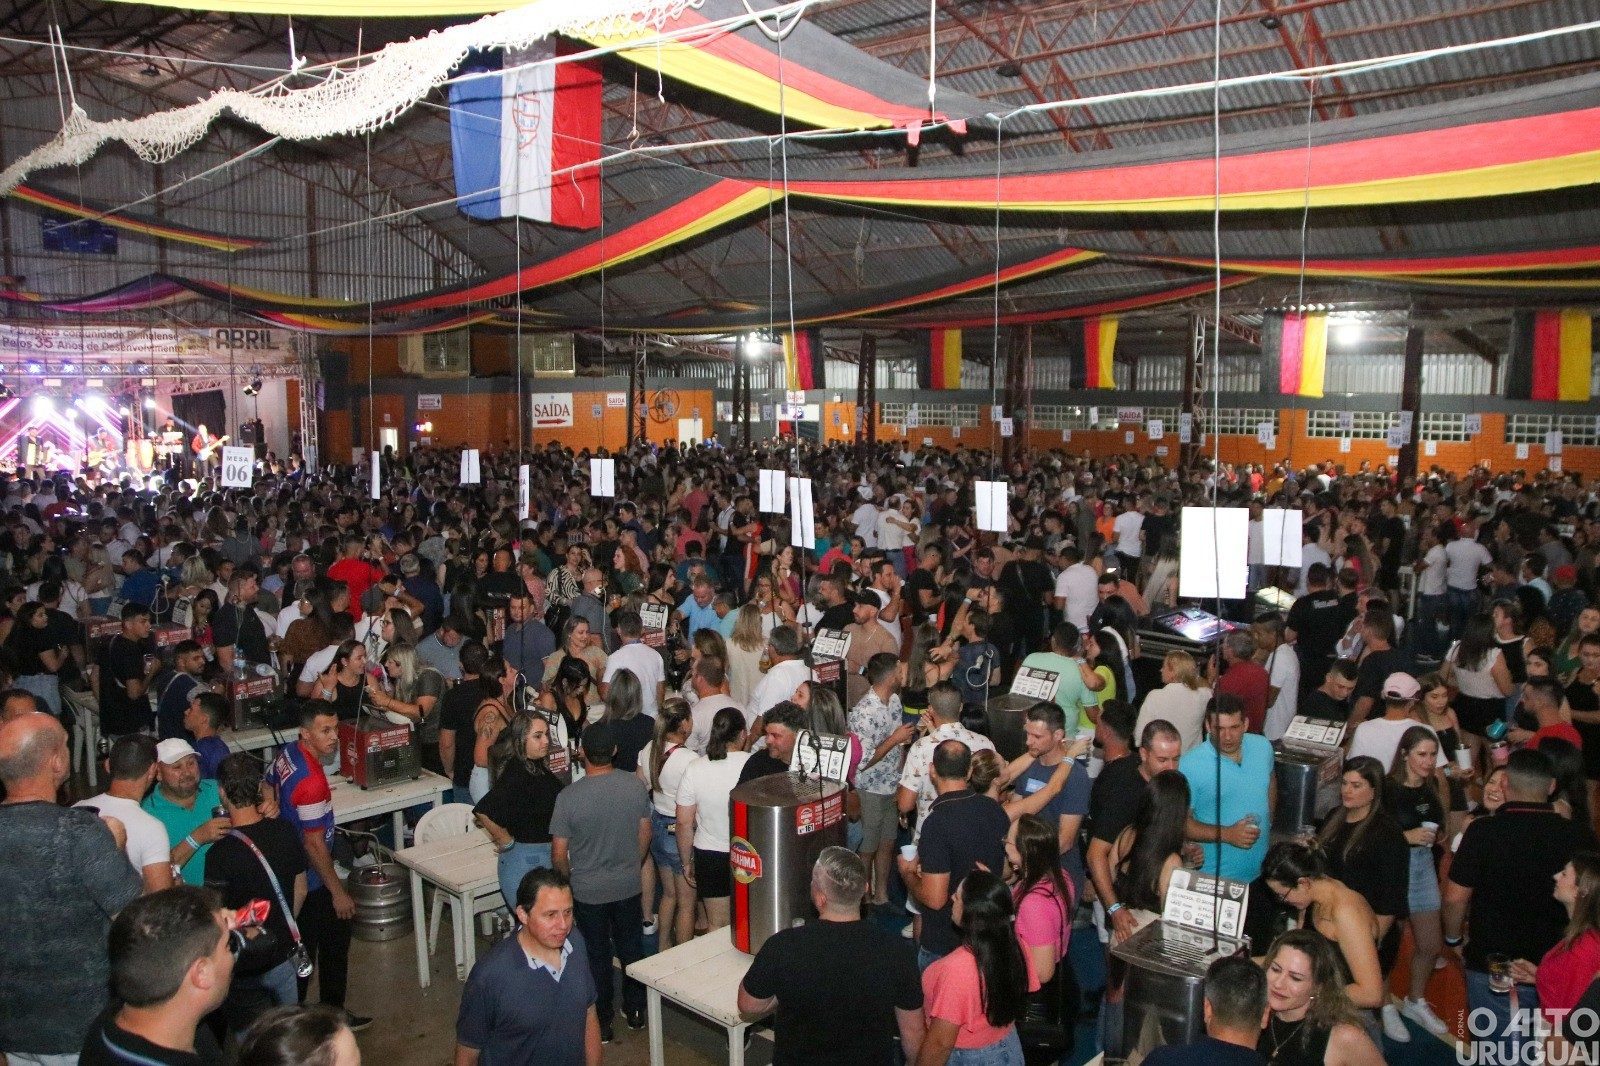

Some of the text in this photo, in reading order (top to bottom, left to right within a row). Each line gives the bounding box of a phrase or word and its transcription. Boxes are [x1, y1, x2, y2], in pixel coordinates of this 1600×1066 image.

[34, 336, 54, 349] 35
[215, 328, 280, 350] ABRIL
[533, 401, 571, 418] SAÍDA
[226, 455, 249, 463] MESA
[226, 463, 248, 483] 06
[730, 849, 757, 870] RAHMA
